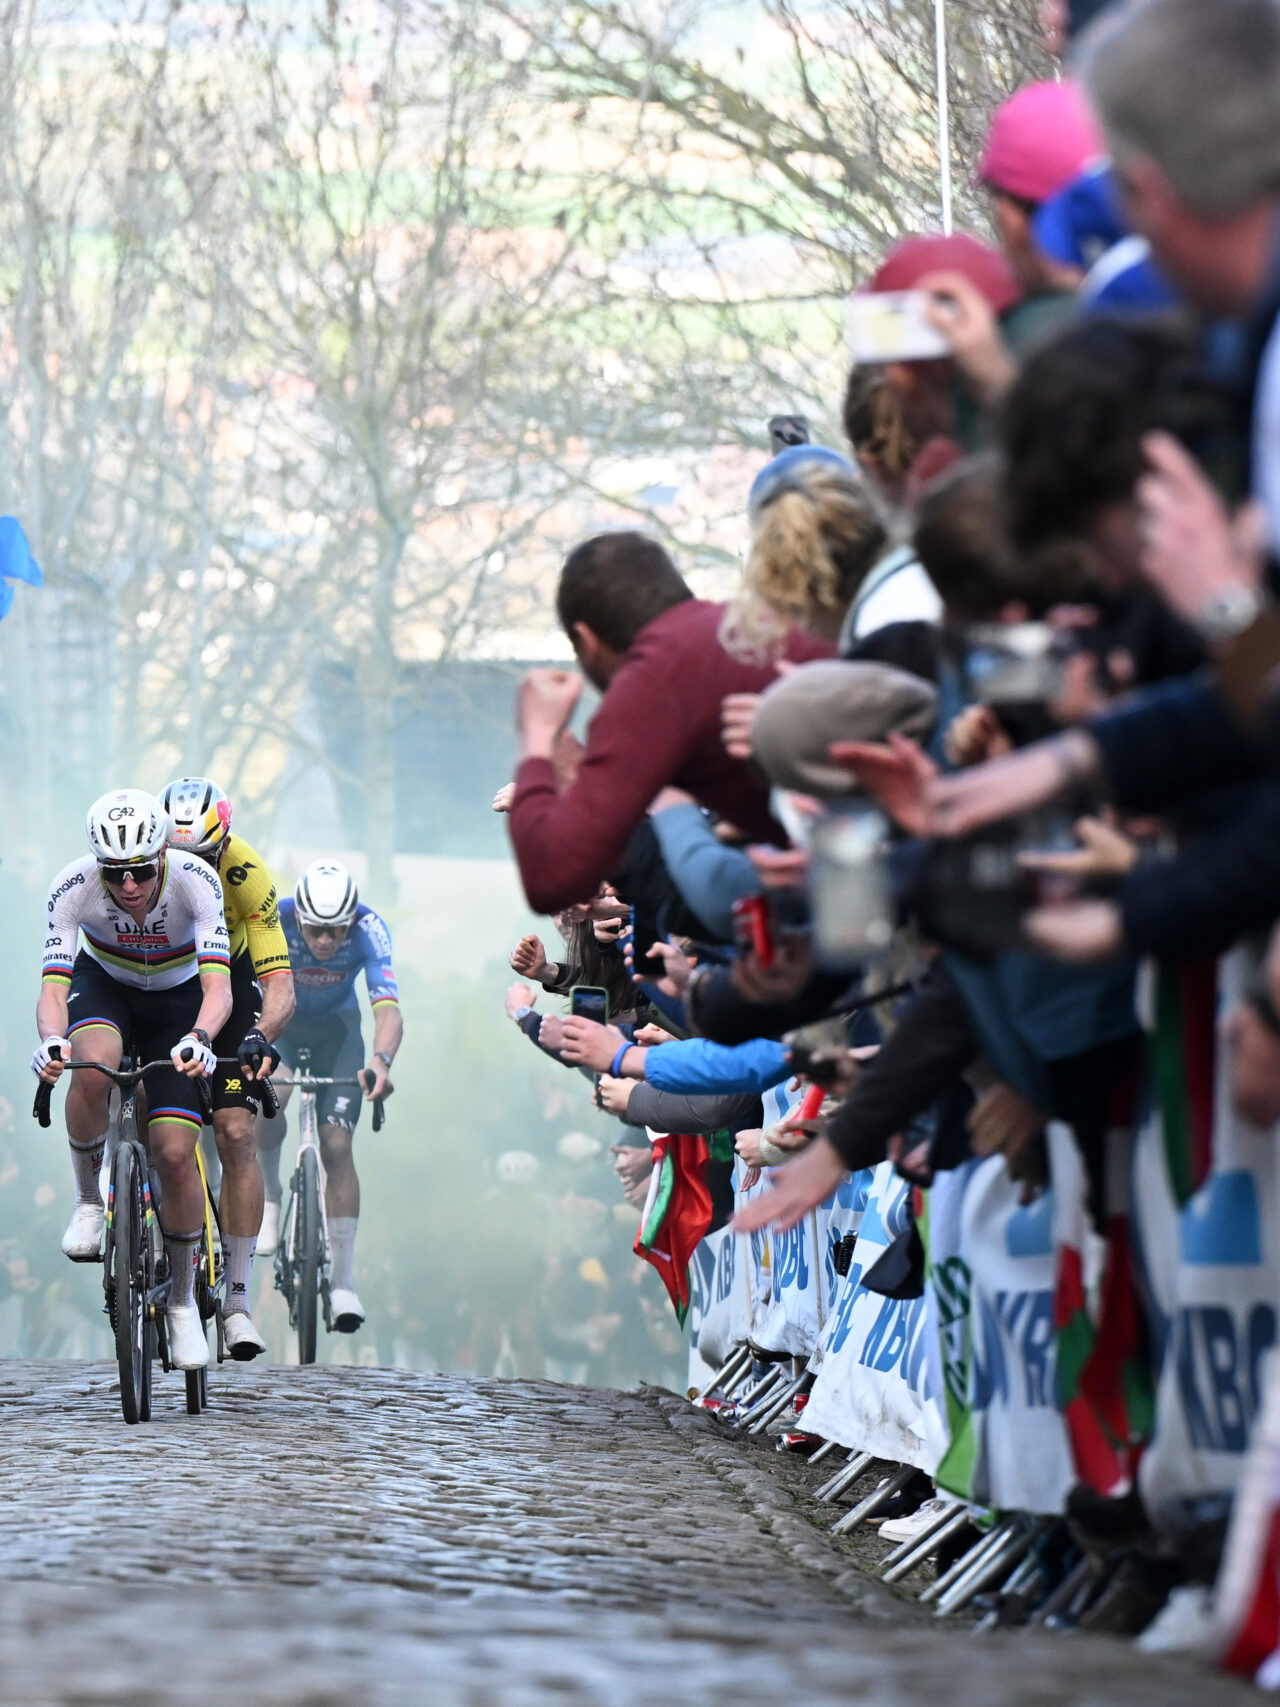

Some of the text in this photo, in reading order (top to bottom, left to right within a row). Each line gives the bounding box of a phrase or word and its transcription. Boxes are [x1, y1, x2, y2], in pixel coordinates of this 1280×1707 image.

[108, 807, 135, 821] G42
[51, 873, 85, 903] Analog
[191, 866, 223, 900] Analog
[115, 919, 166, 935] UAE
